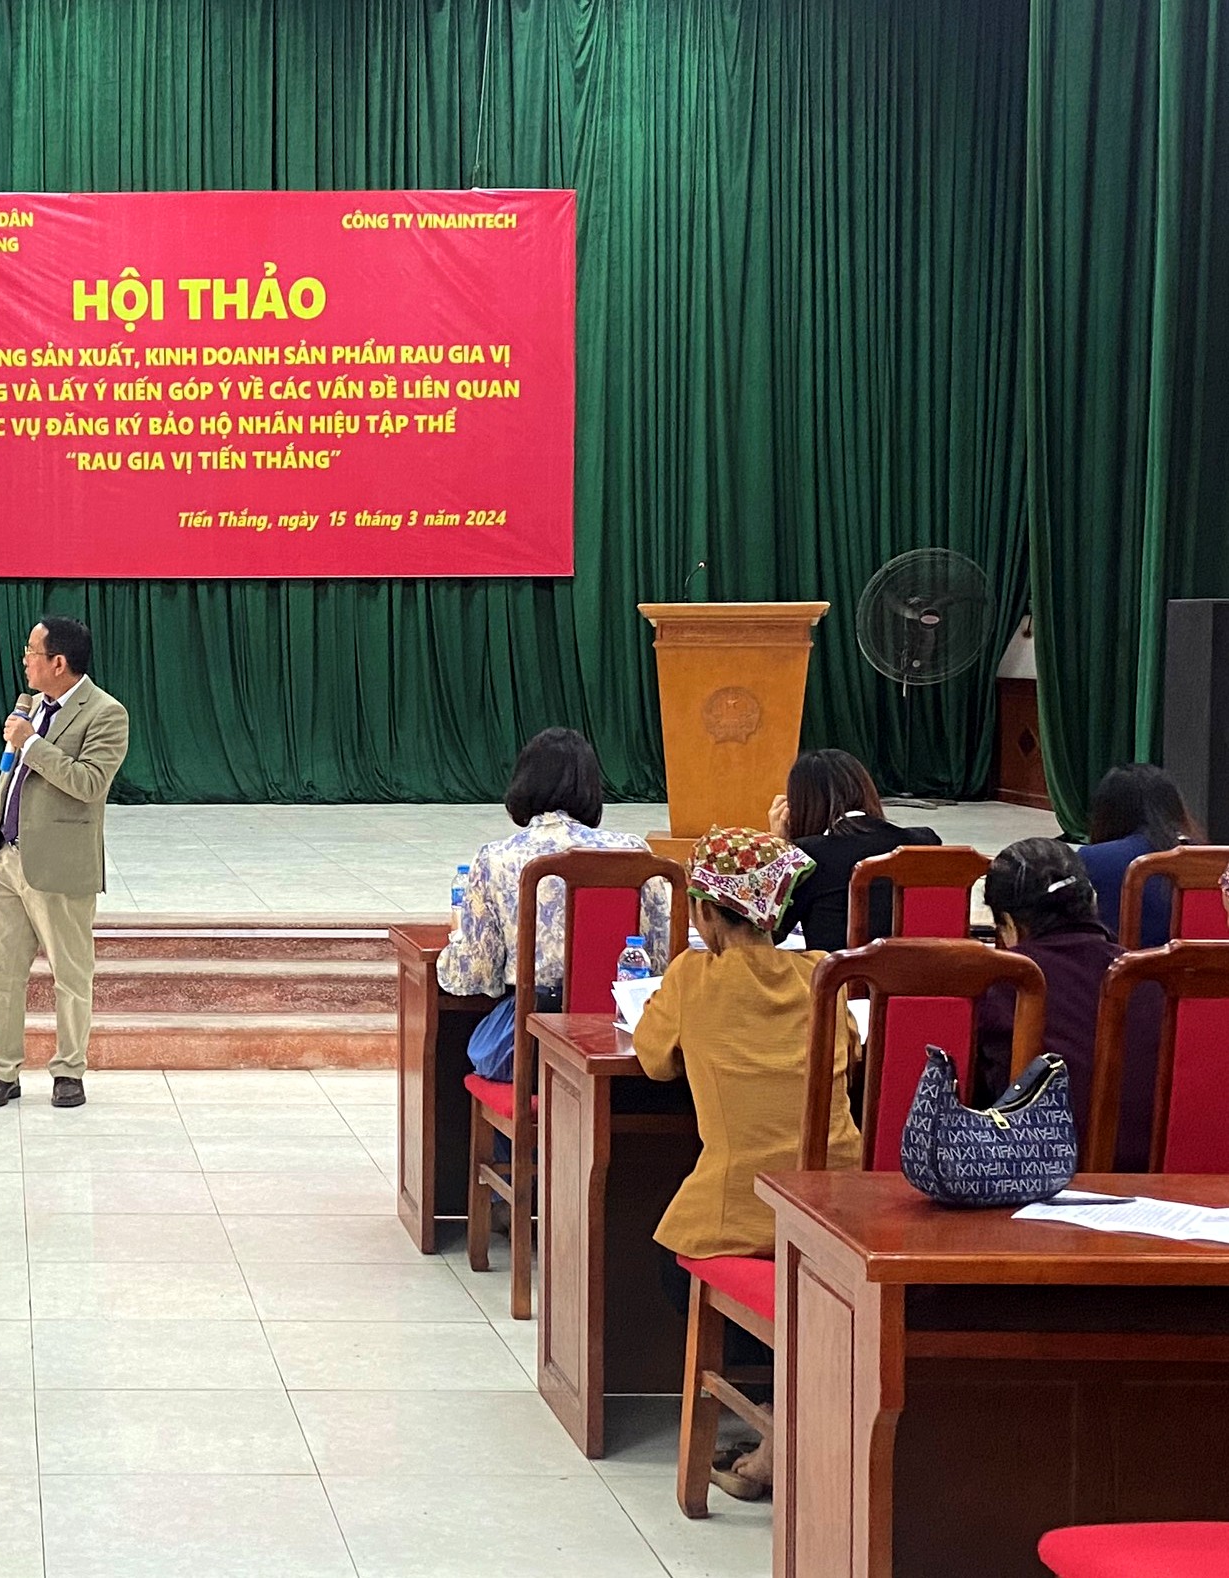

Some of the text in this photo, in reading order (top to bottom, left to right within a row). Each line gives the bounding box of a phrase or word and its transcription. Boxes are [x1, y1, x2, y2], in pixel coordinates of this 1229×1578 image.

[341, 209, 517, 230] CÔNG TY VINAINTECH
[72, 261, 327, 333] HỘI THẢO
[31, 341, 74, 368] SẢN
[78, 341, 141, 369] XUẤT,
[145, 346, 198, 367] KINH
[202, 346, 280, 366] DOANH
[283, 339, 327, 366] SẢN
[331, 337, 396, 365] PHẨM
[400, 344, 444, 364] RAU
[447, 344, 486, 364] GIA
[488, 344, 511, 369] VỊ
[11, 378, 43, 402] VÀ
[48, 376, 89, 402] LẤY
[93, 378, 108, 402] Ý
[113, 376, 163, 402] KIẾN
[167, 376, 214, 401] GÓP
[218, 376, 233, 401] Ý
[237, 375, 265, 400] VỀ
[269, 375, 312, 400] CÁC
[316, 374, 364, 400] VẤN
[368, 374, 398, 399] ĐỀ
[403, 374, 450, 399] LIÊN
[455, 379, 520, 401] QUAN
[10, 417, 41, 442] VỤ
[44, 412, 110, 437] ĐĂNG
[115, 412, 143, 436] KÝ
[148, 410, 195, 436] BẢO
[199, 411, 233, 440] HỘ
[238, 410, 304, 435] NHÃN
[309, 410, 360, 439] HIỆU
[364, 409, 410, 439] TẬP
[413, 406, 458, 434] THỂ
[65, 442, 342, 475] “RAU GIA VỊ TIẾN THẮNG”
[178, 507, 507, 532] Tiến Thắng, ngày 15 tháng 3 năm 2024
[986, 1143, 1040, 1159] YIFANXI
[991, 1178, 1042, 1193] YIFANXI
